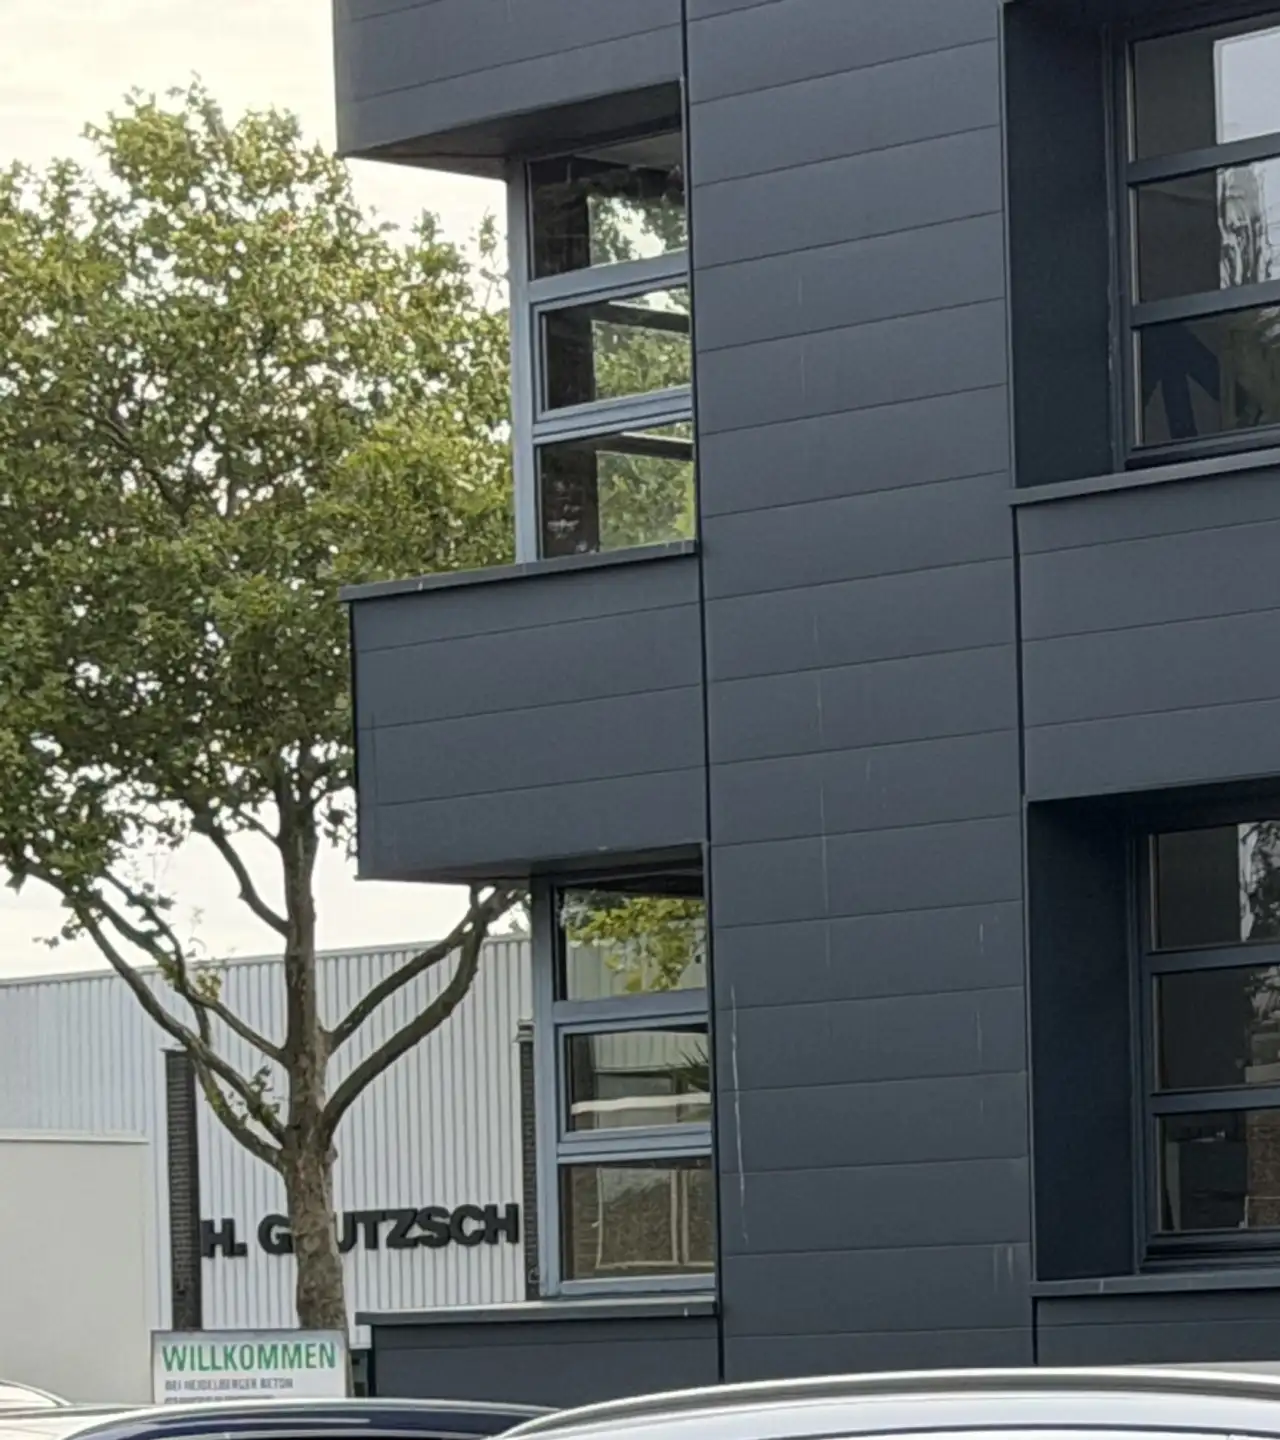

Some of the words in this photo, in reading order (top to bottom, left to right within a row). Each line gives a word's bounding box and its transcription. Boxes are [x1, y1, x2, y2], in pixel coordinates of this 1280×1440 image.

[200, 1217, 249, 1259] H.
[257, 1203, 520, 1256] GUTZSCH
[162, 1342, 337, 1371] WILLKOMMEN
